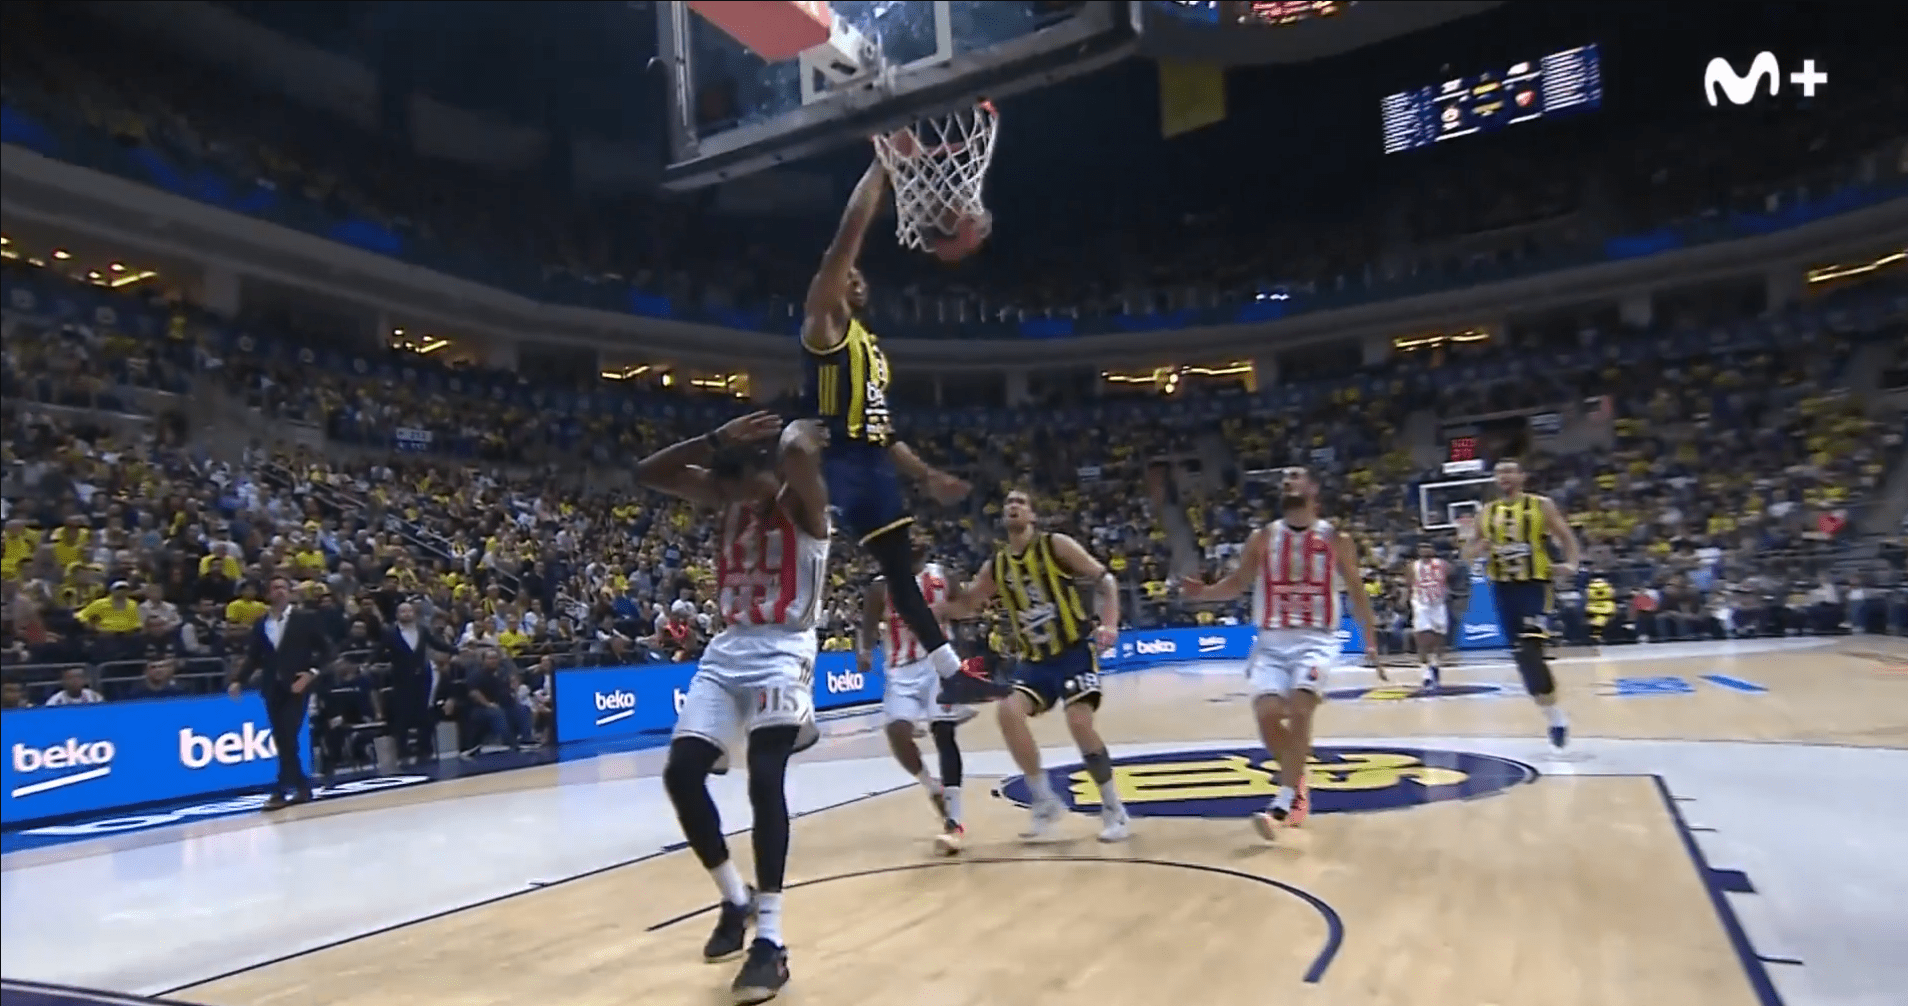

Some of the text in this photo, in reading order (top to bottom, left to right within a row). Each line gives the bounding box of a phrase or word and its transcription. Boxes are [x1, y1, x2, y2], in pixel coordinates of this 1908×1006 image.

[827, 669, 864, 694] beko
[594, 689, 635, 711] beko
[12, 737, 115, 773] beko
[179, 721, 278, 769] bek
